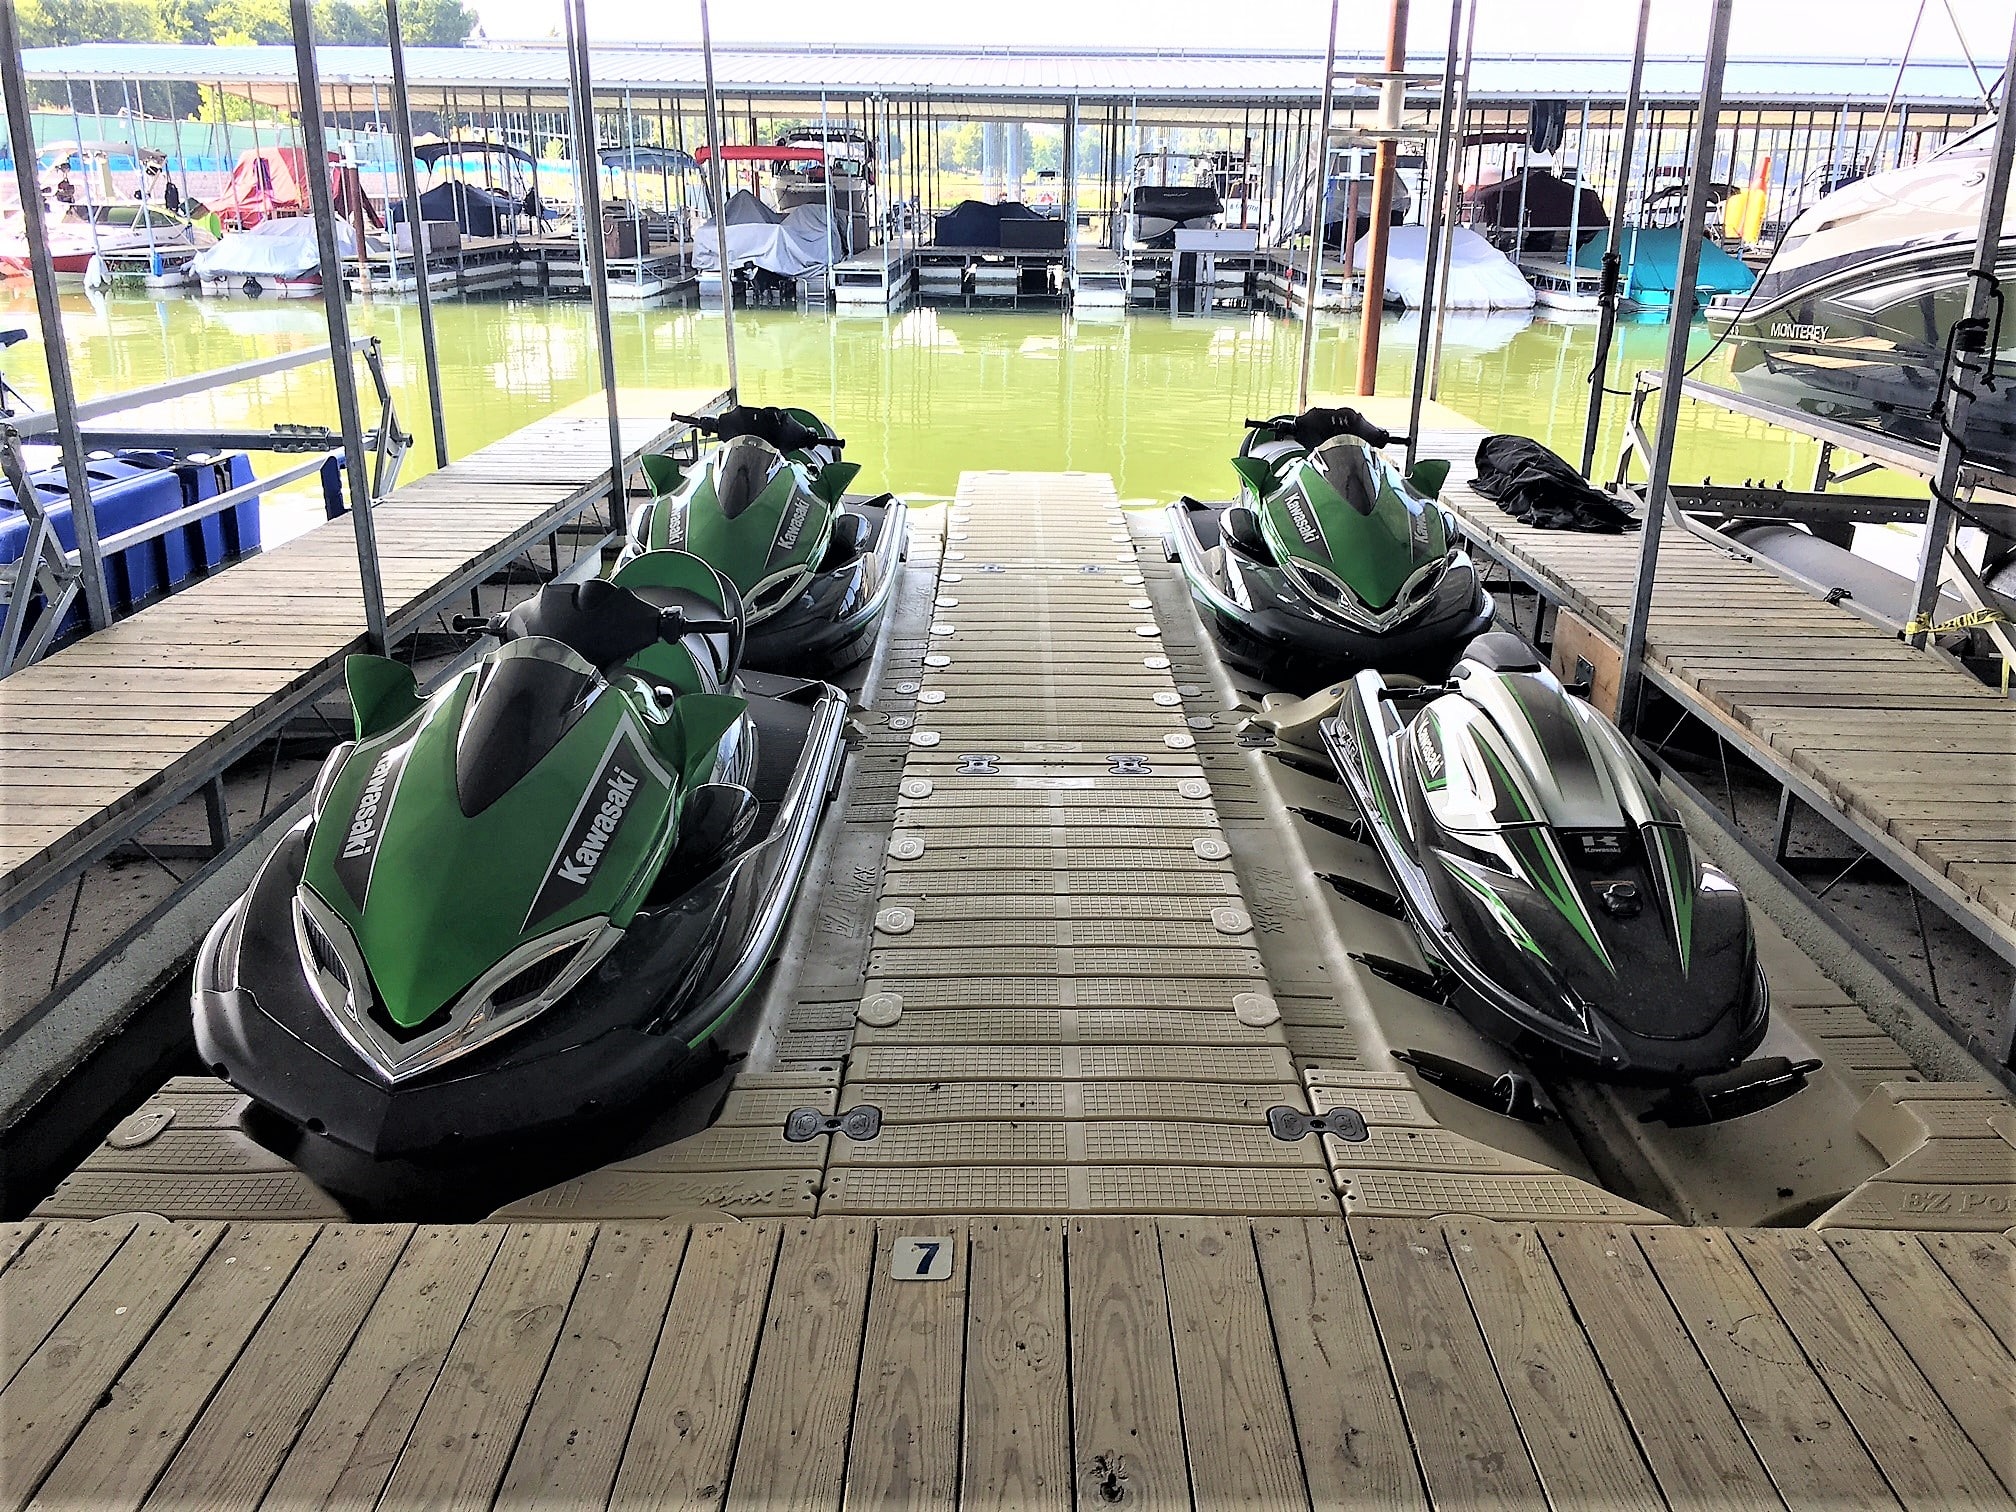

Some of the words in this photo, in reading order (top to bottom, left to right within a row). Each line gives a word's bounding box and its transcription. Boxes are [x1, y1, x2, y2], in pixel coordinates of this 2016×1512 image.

[1770, 323, 1830, 340] MONTEREY
[668, 506, 684, 545] wasaki
[777, 497, 810, 550] Kawasaki
[1285, 492, 1320, 543] Kawasaki
[1417, 716, 1444, 778] Kawasaki
[342, 751, 394, 859] awasaki
[557, 766, 639, 885] Kawasaki
[914, 1243, 940, 1274] 7
